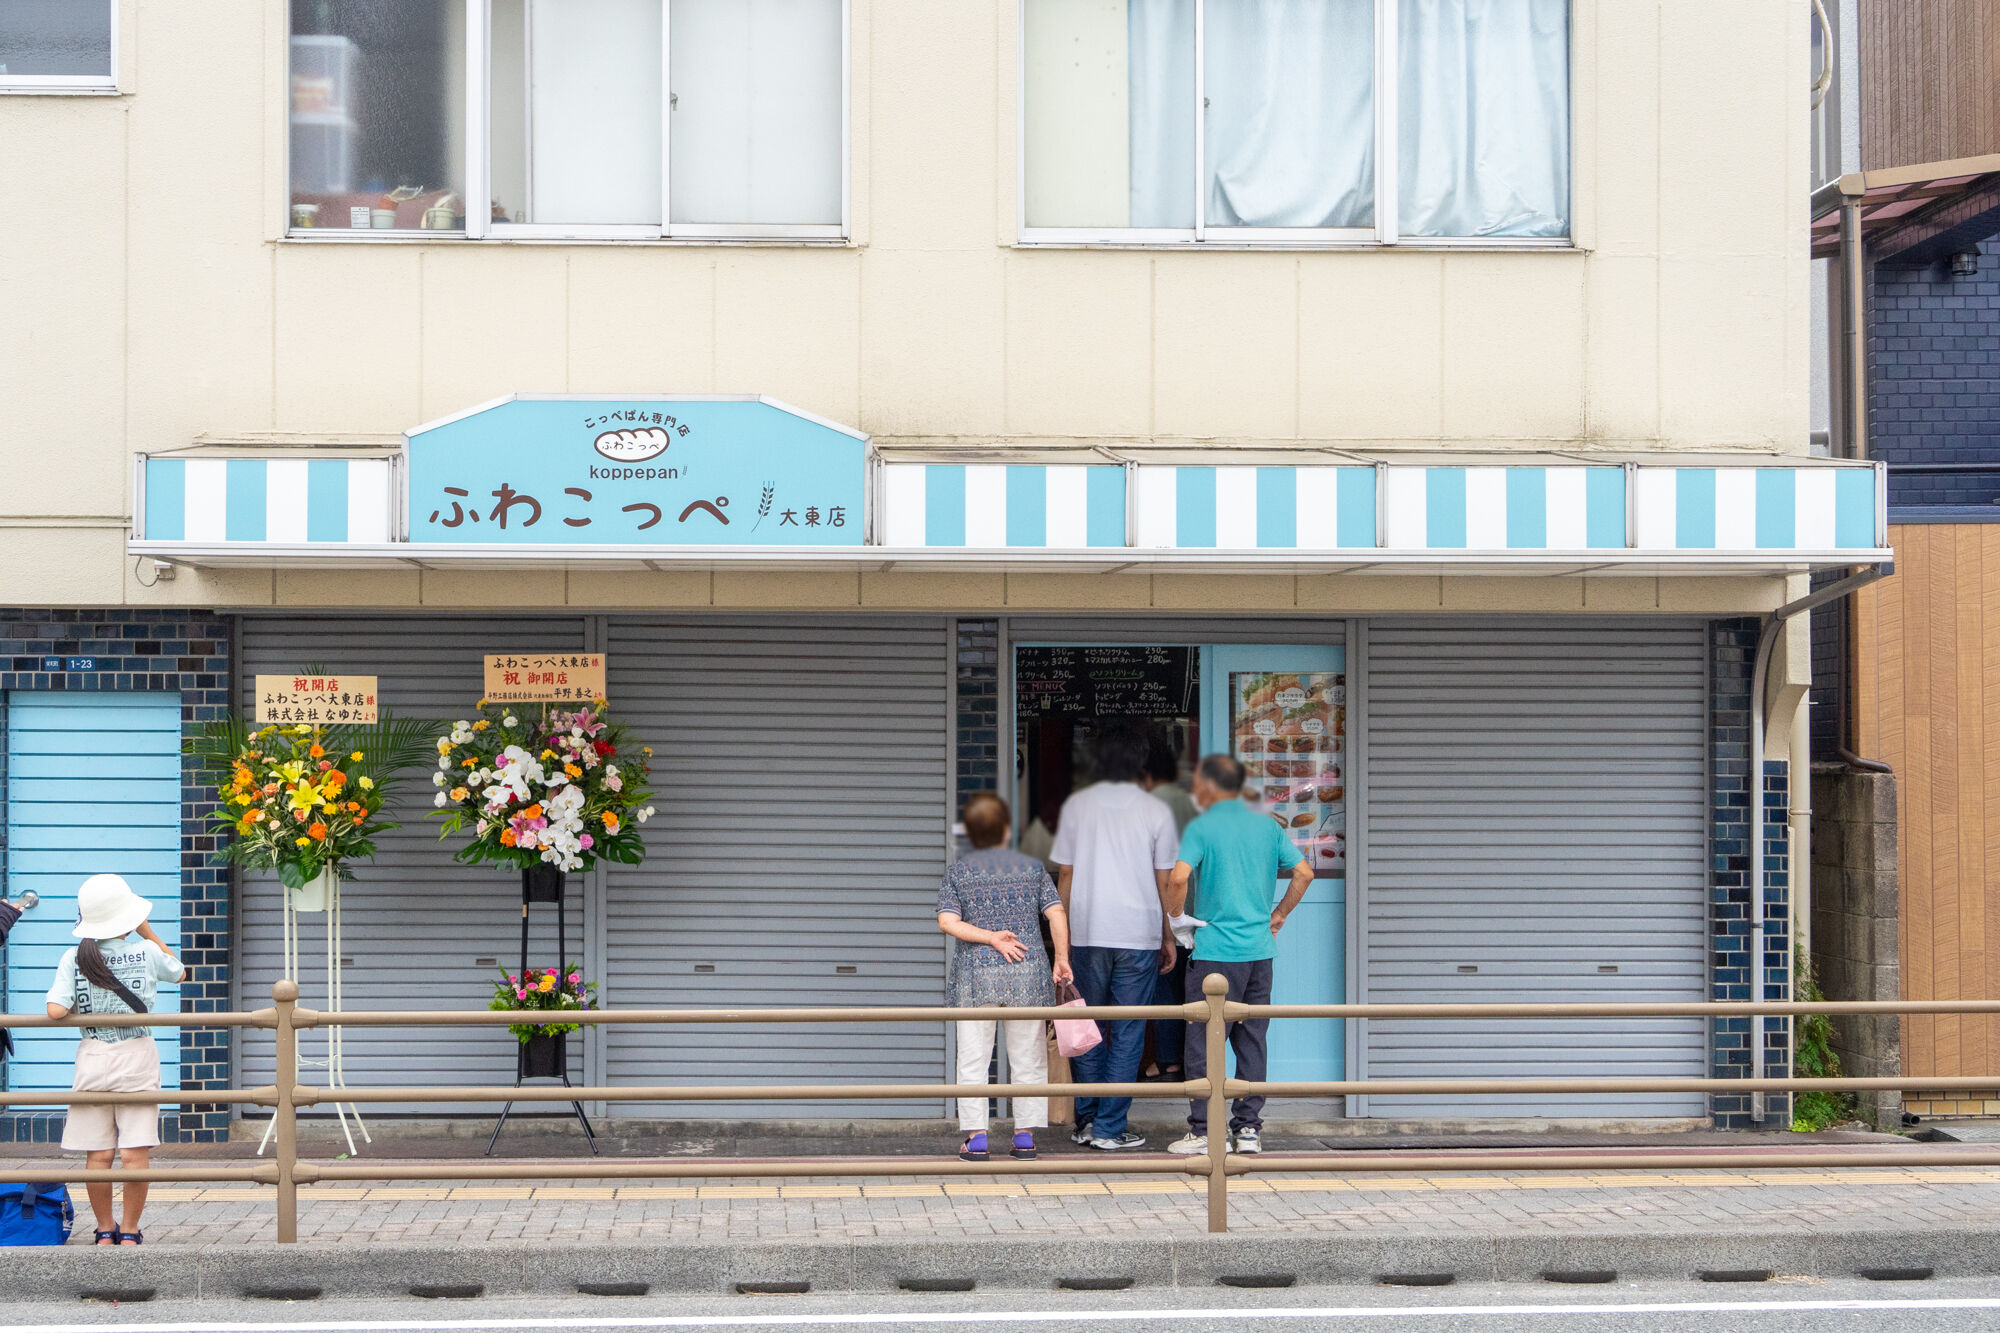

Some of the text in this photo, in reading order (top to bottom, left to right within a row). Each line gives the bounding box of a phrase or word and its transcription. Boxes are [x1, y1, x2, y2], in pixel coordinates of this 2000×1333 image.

[602, 441, 660, 451] ふわこっぺ
[590, 465, 678, 480] koppepan
[429, 483, 846, 531] ふわこっぺ 大東店
[70, 659, 92, 669] 1-23
[293, 677, 339, 692] 祝開店
[503, 671, 568, 686] 祝 御開店
[554, 688, 571, 699] 平野
[267, 707, 320, 721] 株式会社
